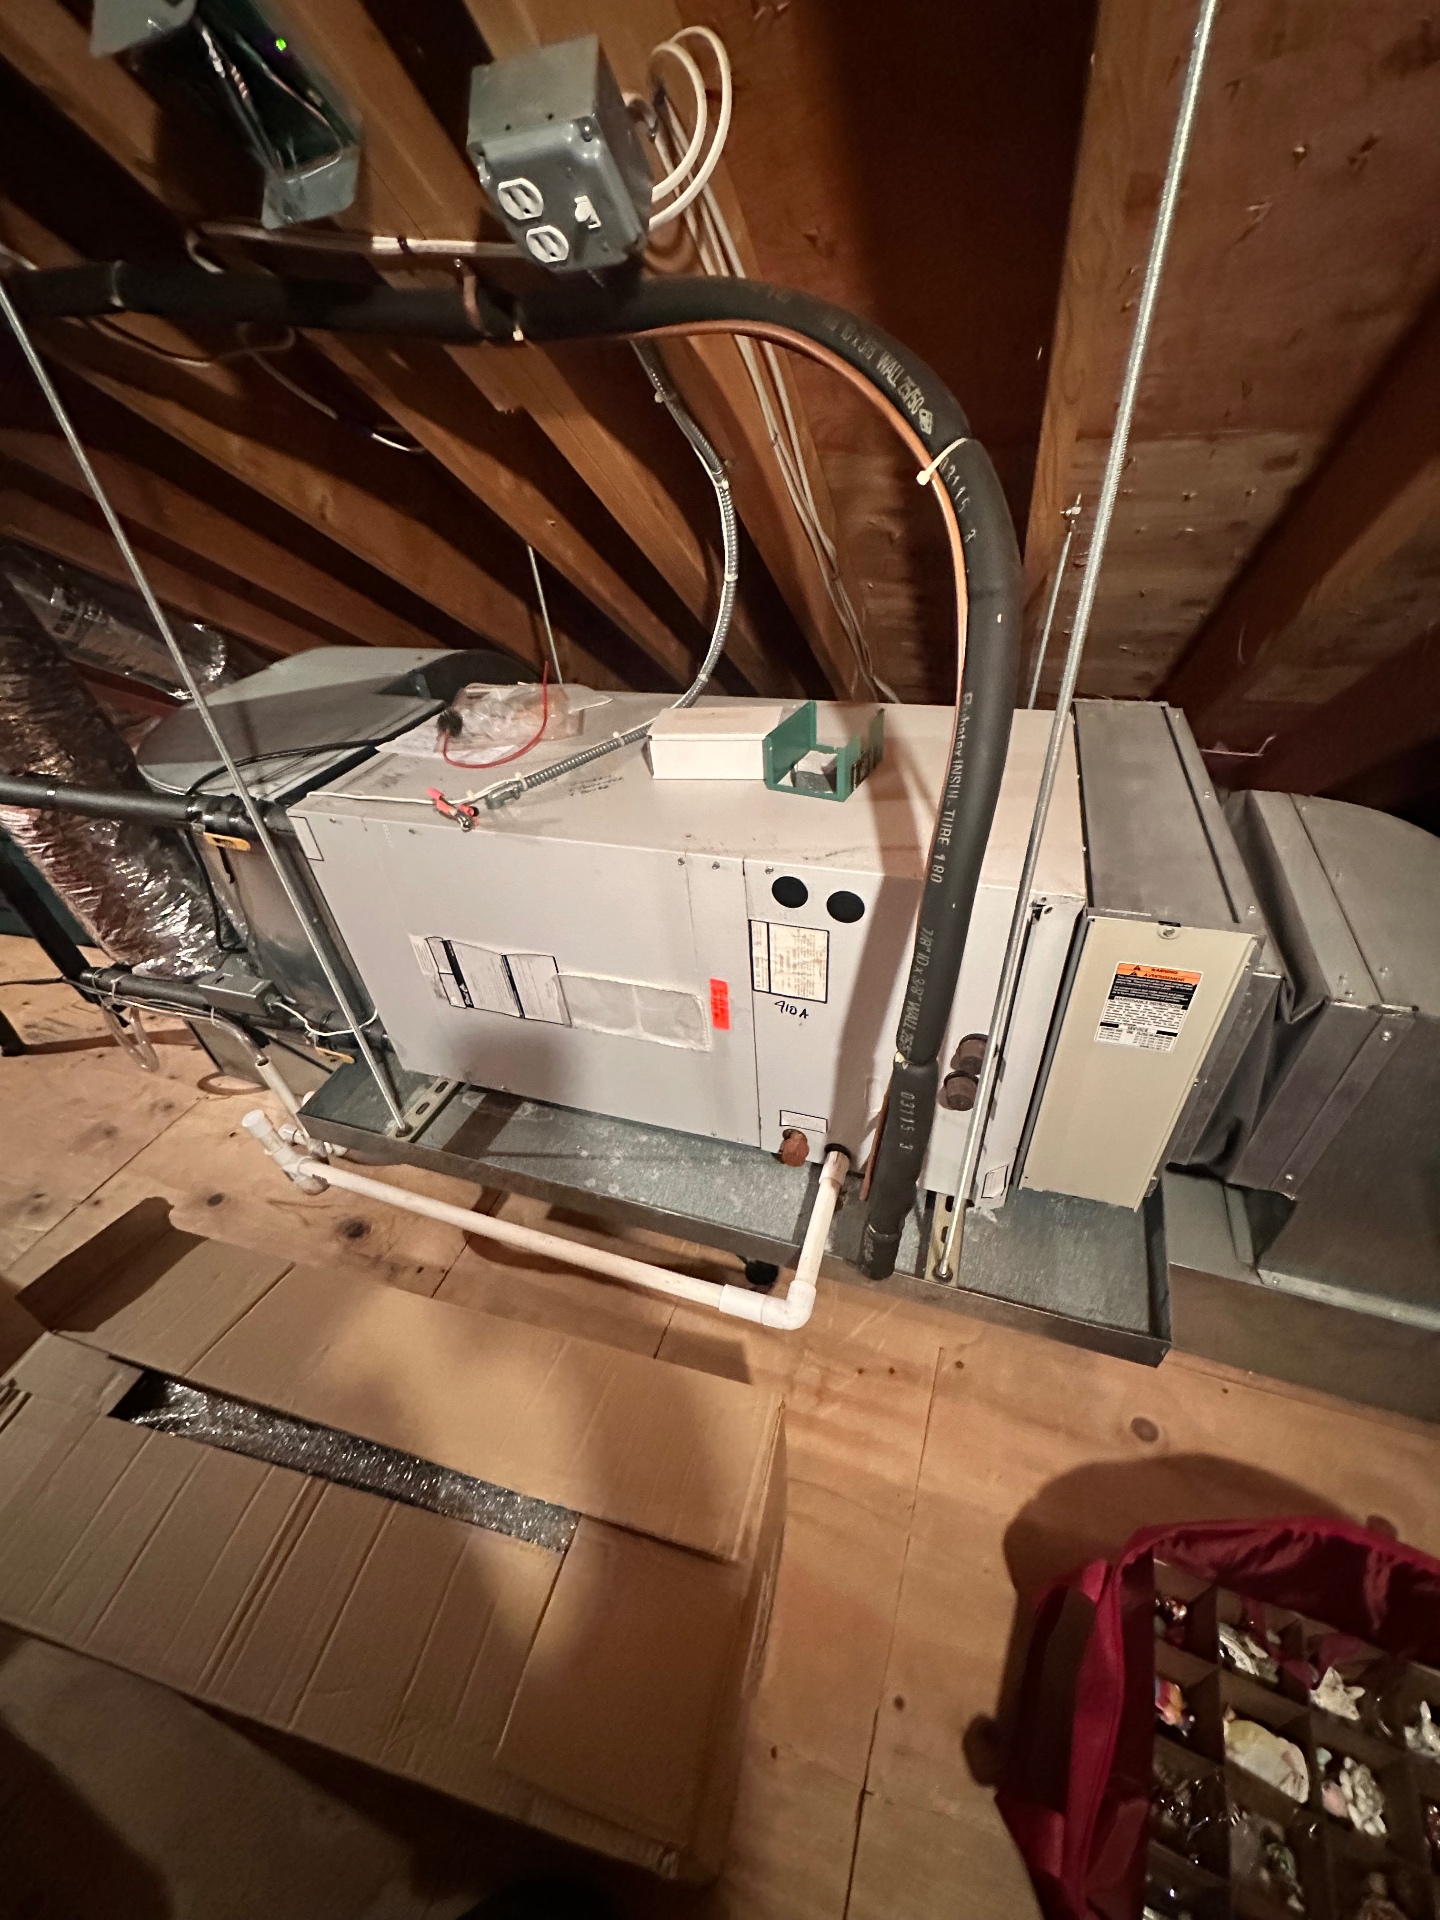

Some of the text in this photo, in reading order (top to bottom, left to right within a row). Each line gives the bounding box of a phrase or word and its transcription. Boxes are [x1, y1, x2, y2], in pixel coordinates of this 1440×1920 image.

[876, 351, 905, 388] WALL
[930, 853, 946, 884] 180
[915, 952, 930, 967] ID
[903, 1001, 921, 1031] WALL
